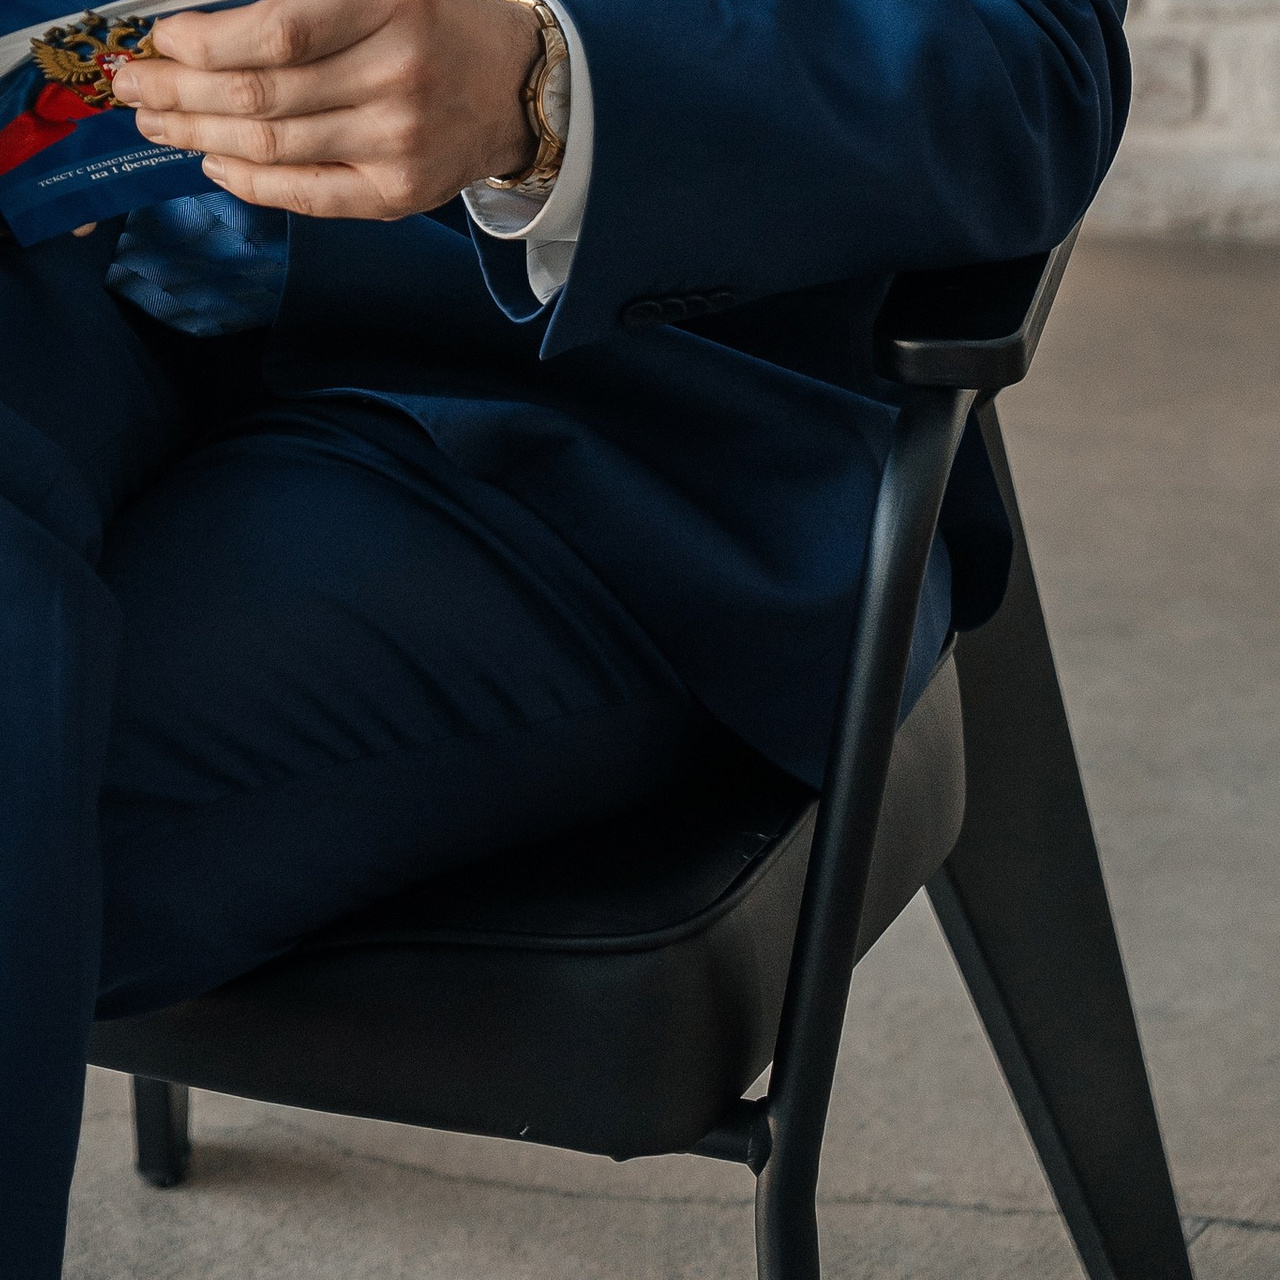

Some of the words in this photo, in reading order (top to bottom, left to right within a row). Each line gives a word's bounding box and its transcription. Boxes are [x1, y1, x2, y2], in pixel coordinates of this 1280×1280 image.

[38, 170, 73, 188] текст
[76, 166, 84, 175] с
[90, 171, 109, 181] на
[111, 166, 119, 175] 1
[121, 152, 183, 172] февраля
